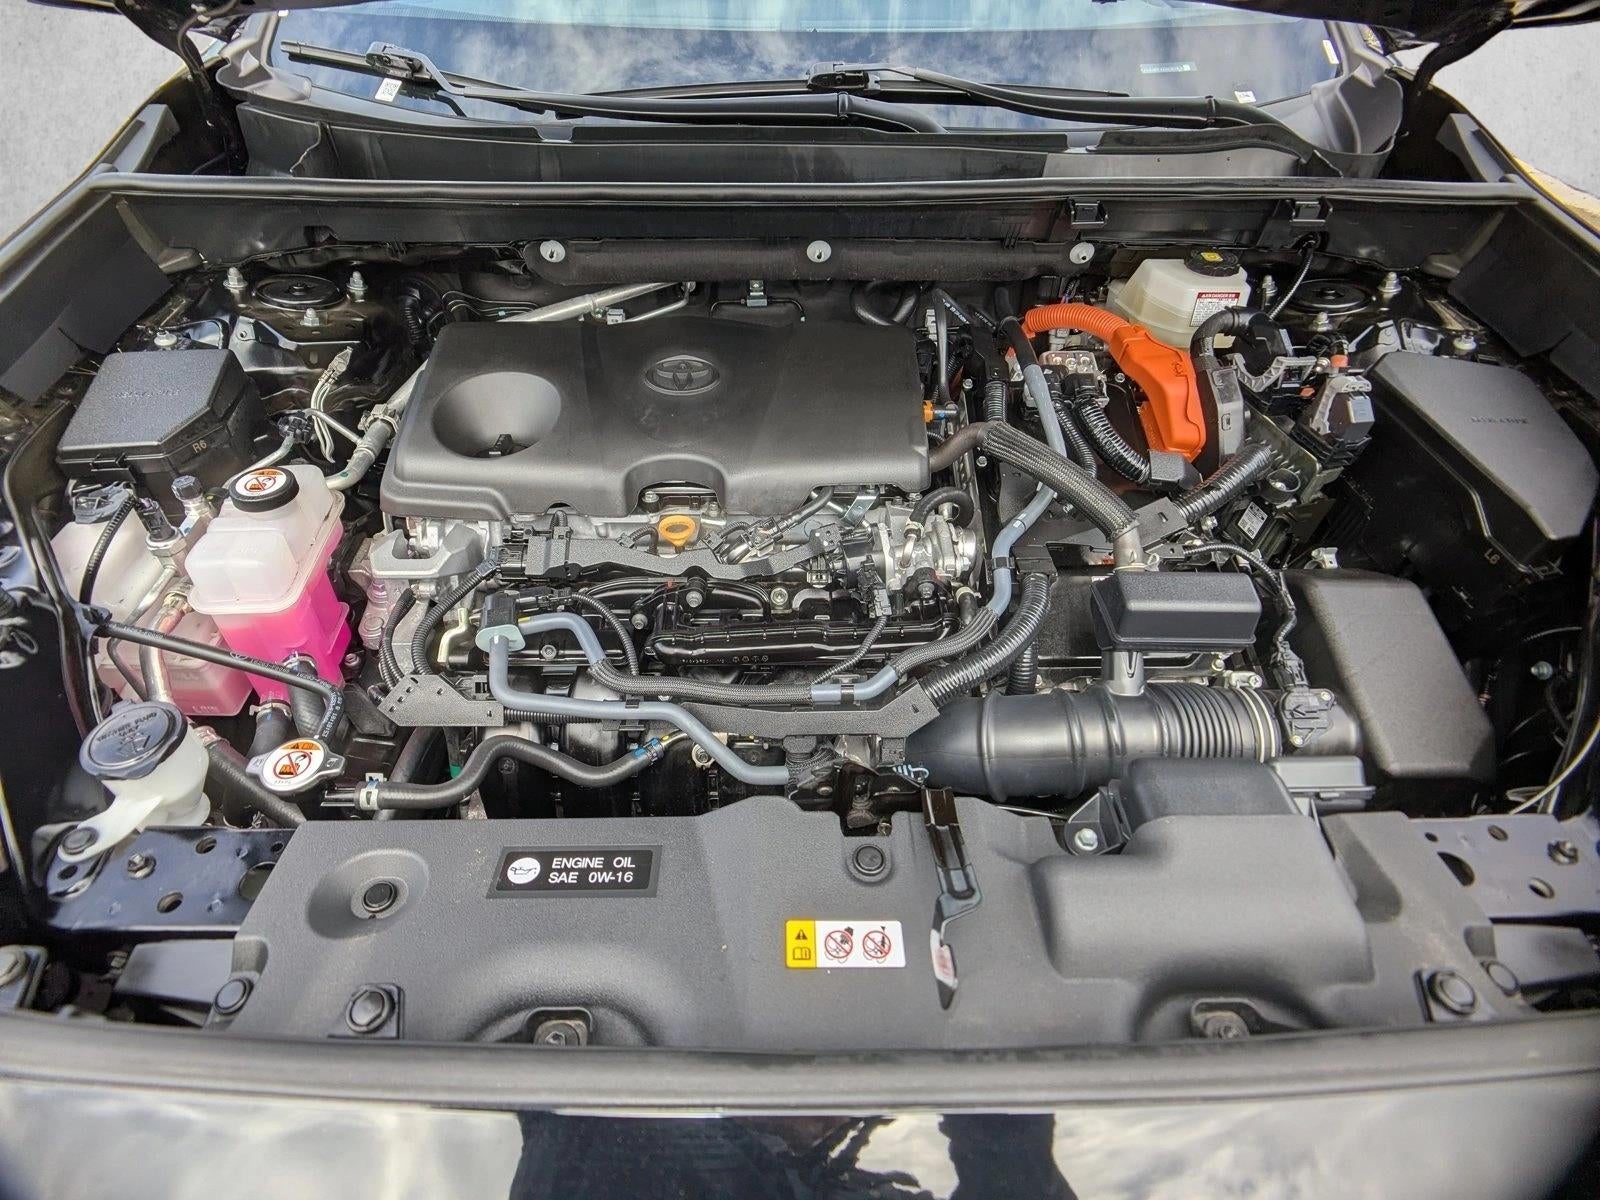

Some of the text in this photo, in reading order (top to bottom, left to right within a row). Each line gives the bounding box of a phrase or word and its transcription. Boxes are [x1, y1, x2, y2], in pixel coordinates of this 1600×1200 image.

[192, 440, 207, 454] R6
[1484, 548, 1500, 565] L6
[551, 856, 636, 869] ENGINE OIL
[548, 871, 634, 884] SAE 0W-16
